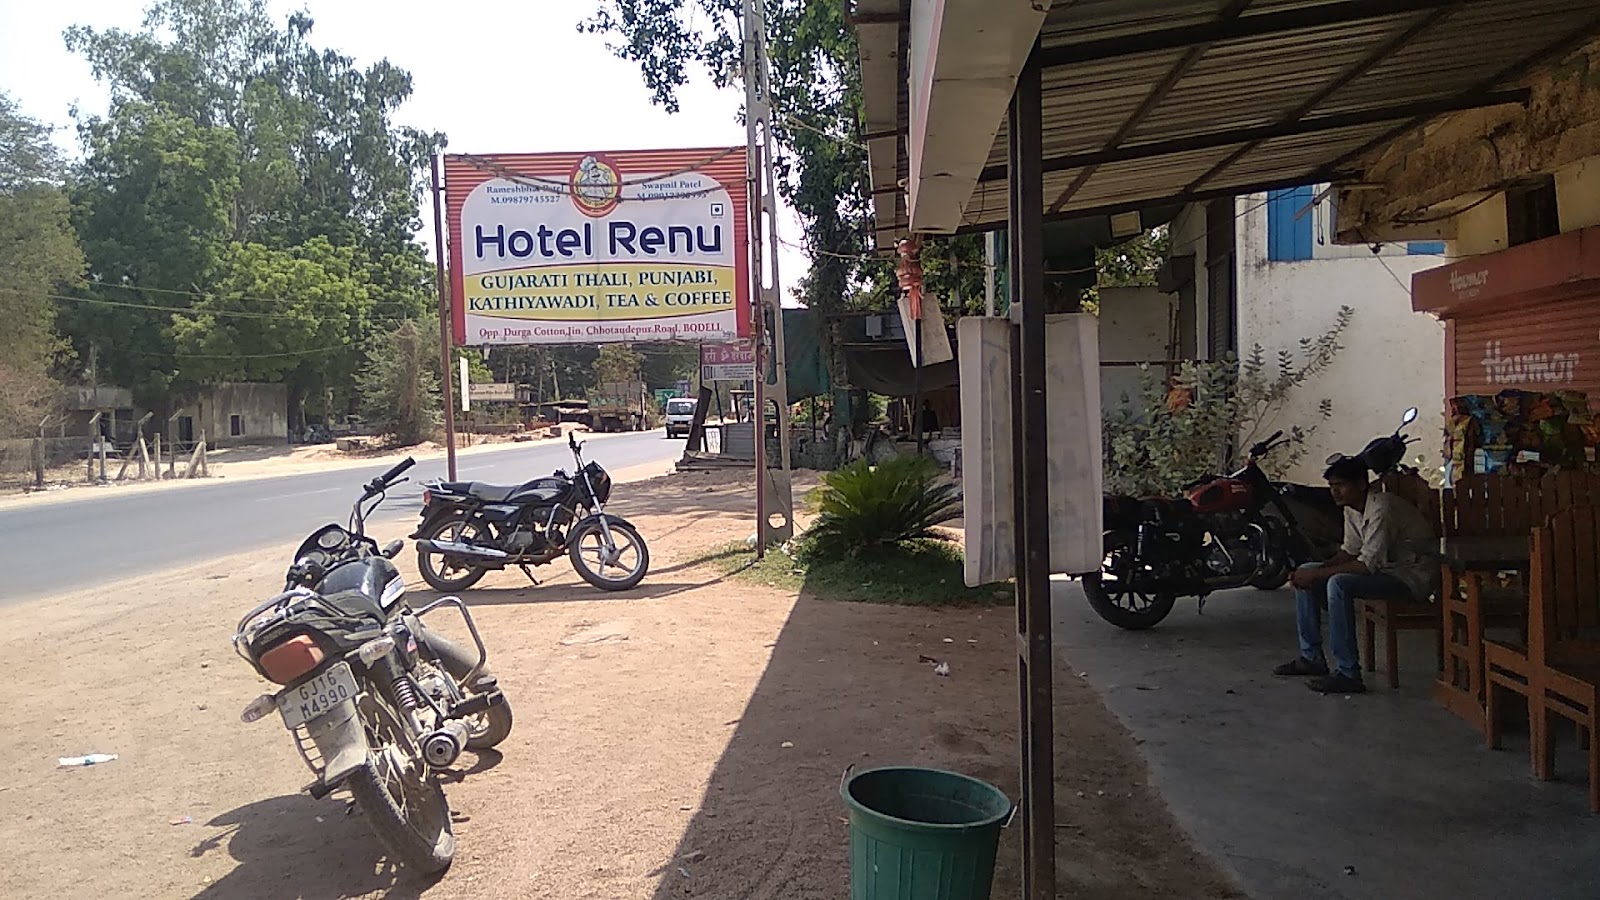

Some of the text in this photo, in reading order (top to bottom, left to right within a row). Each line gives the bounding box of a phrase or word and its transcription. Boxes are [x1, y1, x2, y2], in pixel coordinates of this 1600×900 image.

[642, 180, 701, 191] Swapnil Patel
[475, 221, 721, 258] Hotel Renu
[481, 270, 718, 291] GUJARATI THALI, PUNJABI,
[469, 291, 732, 311] KATHIYAWADI, TEA & COFFEE
[504, 327, 532, 339] Durga
[299, 671, 337, 701] GJ16
[300, 684, 348, 720] M4990
